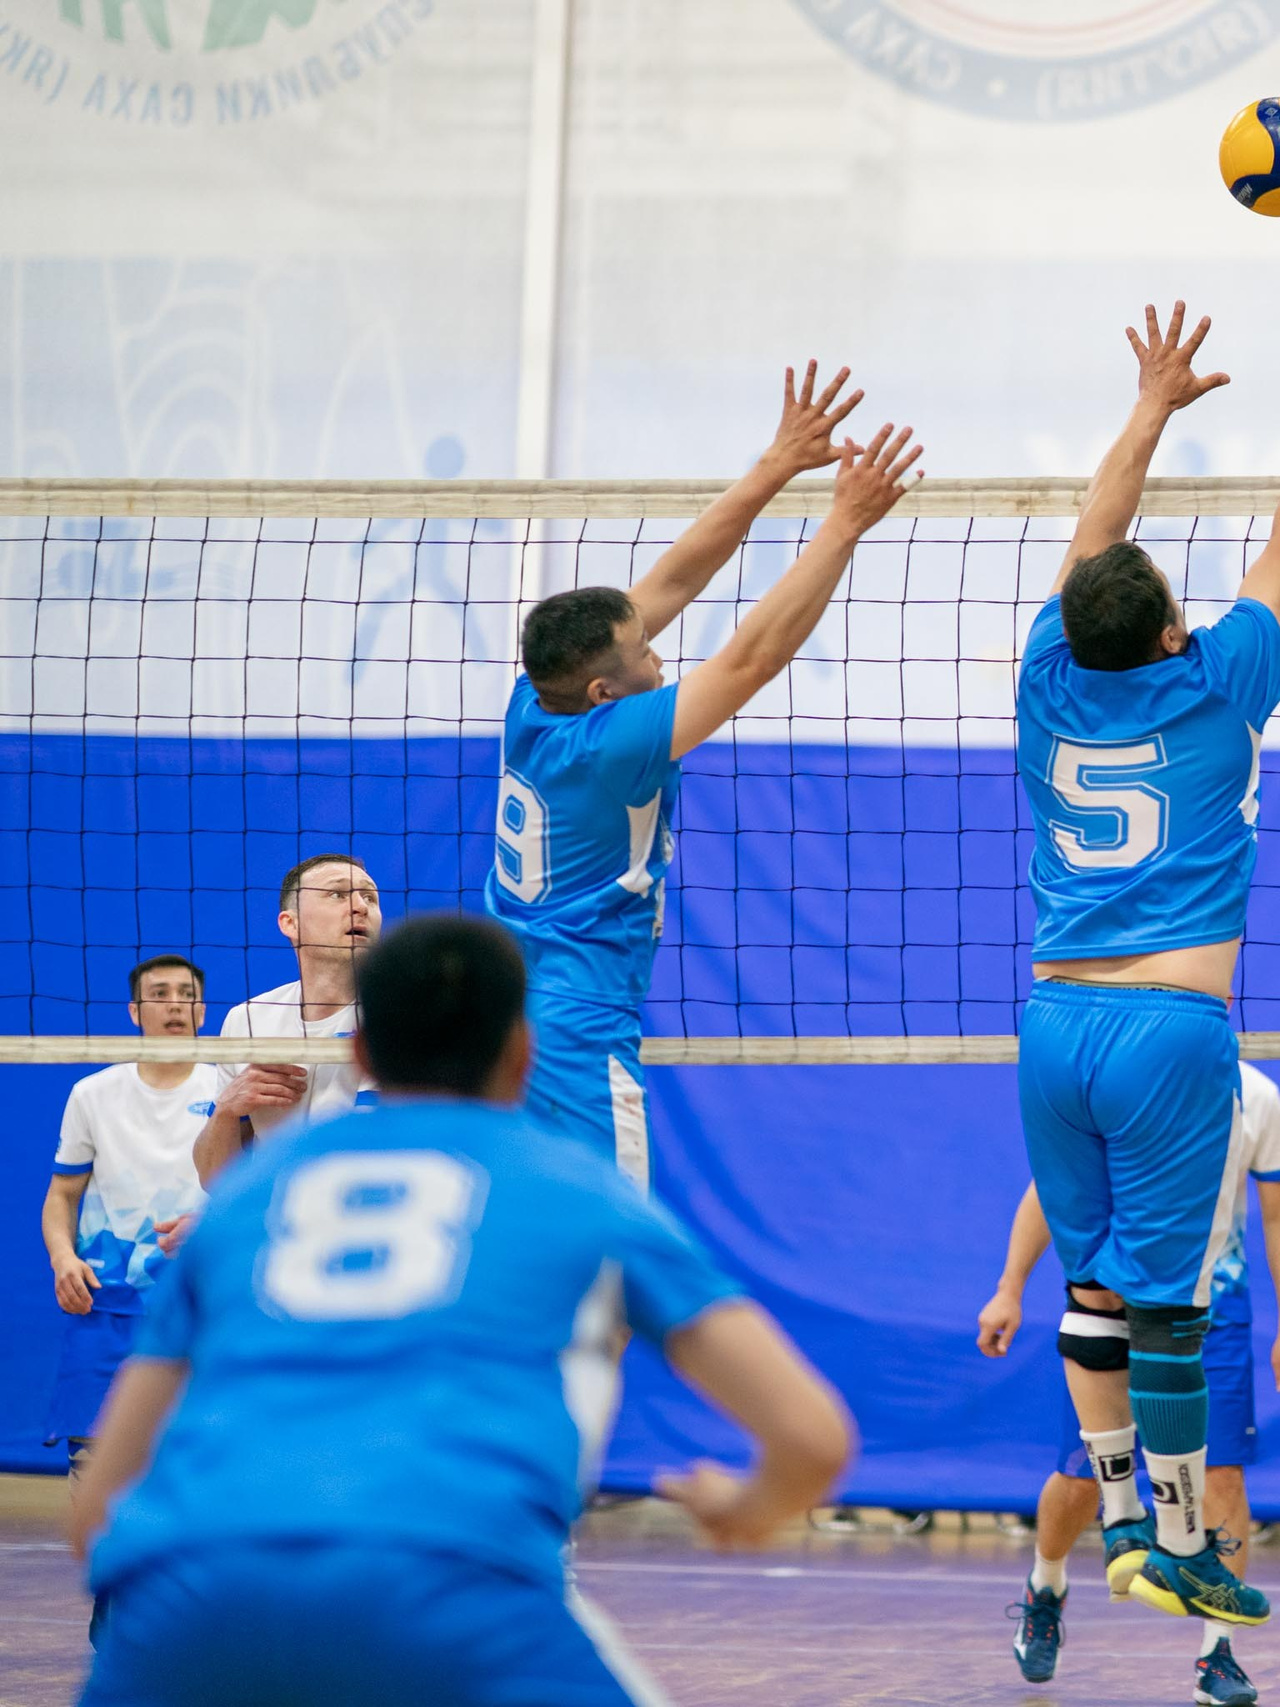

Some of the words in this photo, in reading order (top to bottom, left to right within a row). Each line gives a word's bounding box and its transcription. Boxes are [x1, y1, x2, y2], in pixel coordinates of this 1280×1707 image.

[495, 765, 552, 904] 9
[1045, 733, 1169, 873] 5
[260, 1149, 482, 1323] 8
